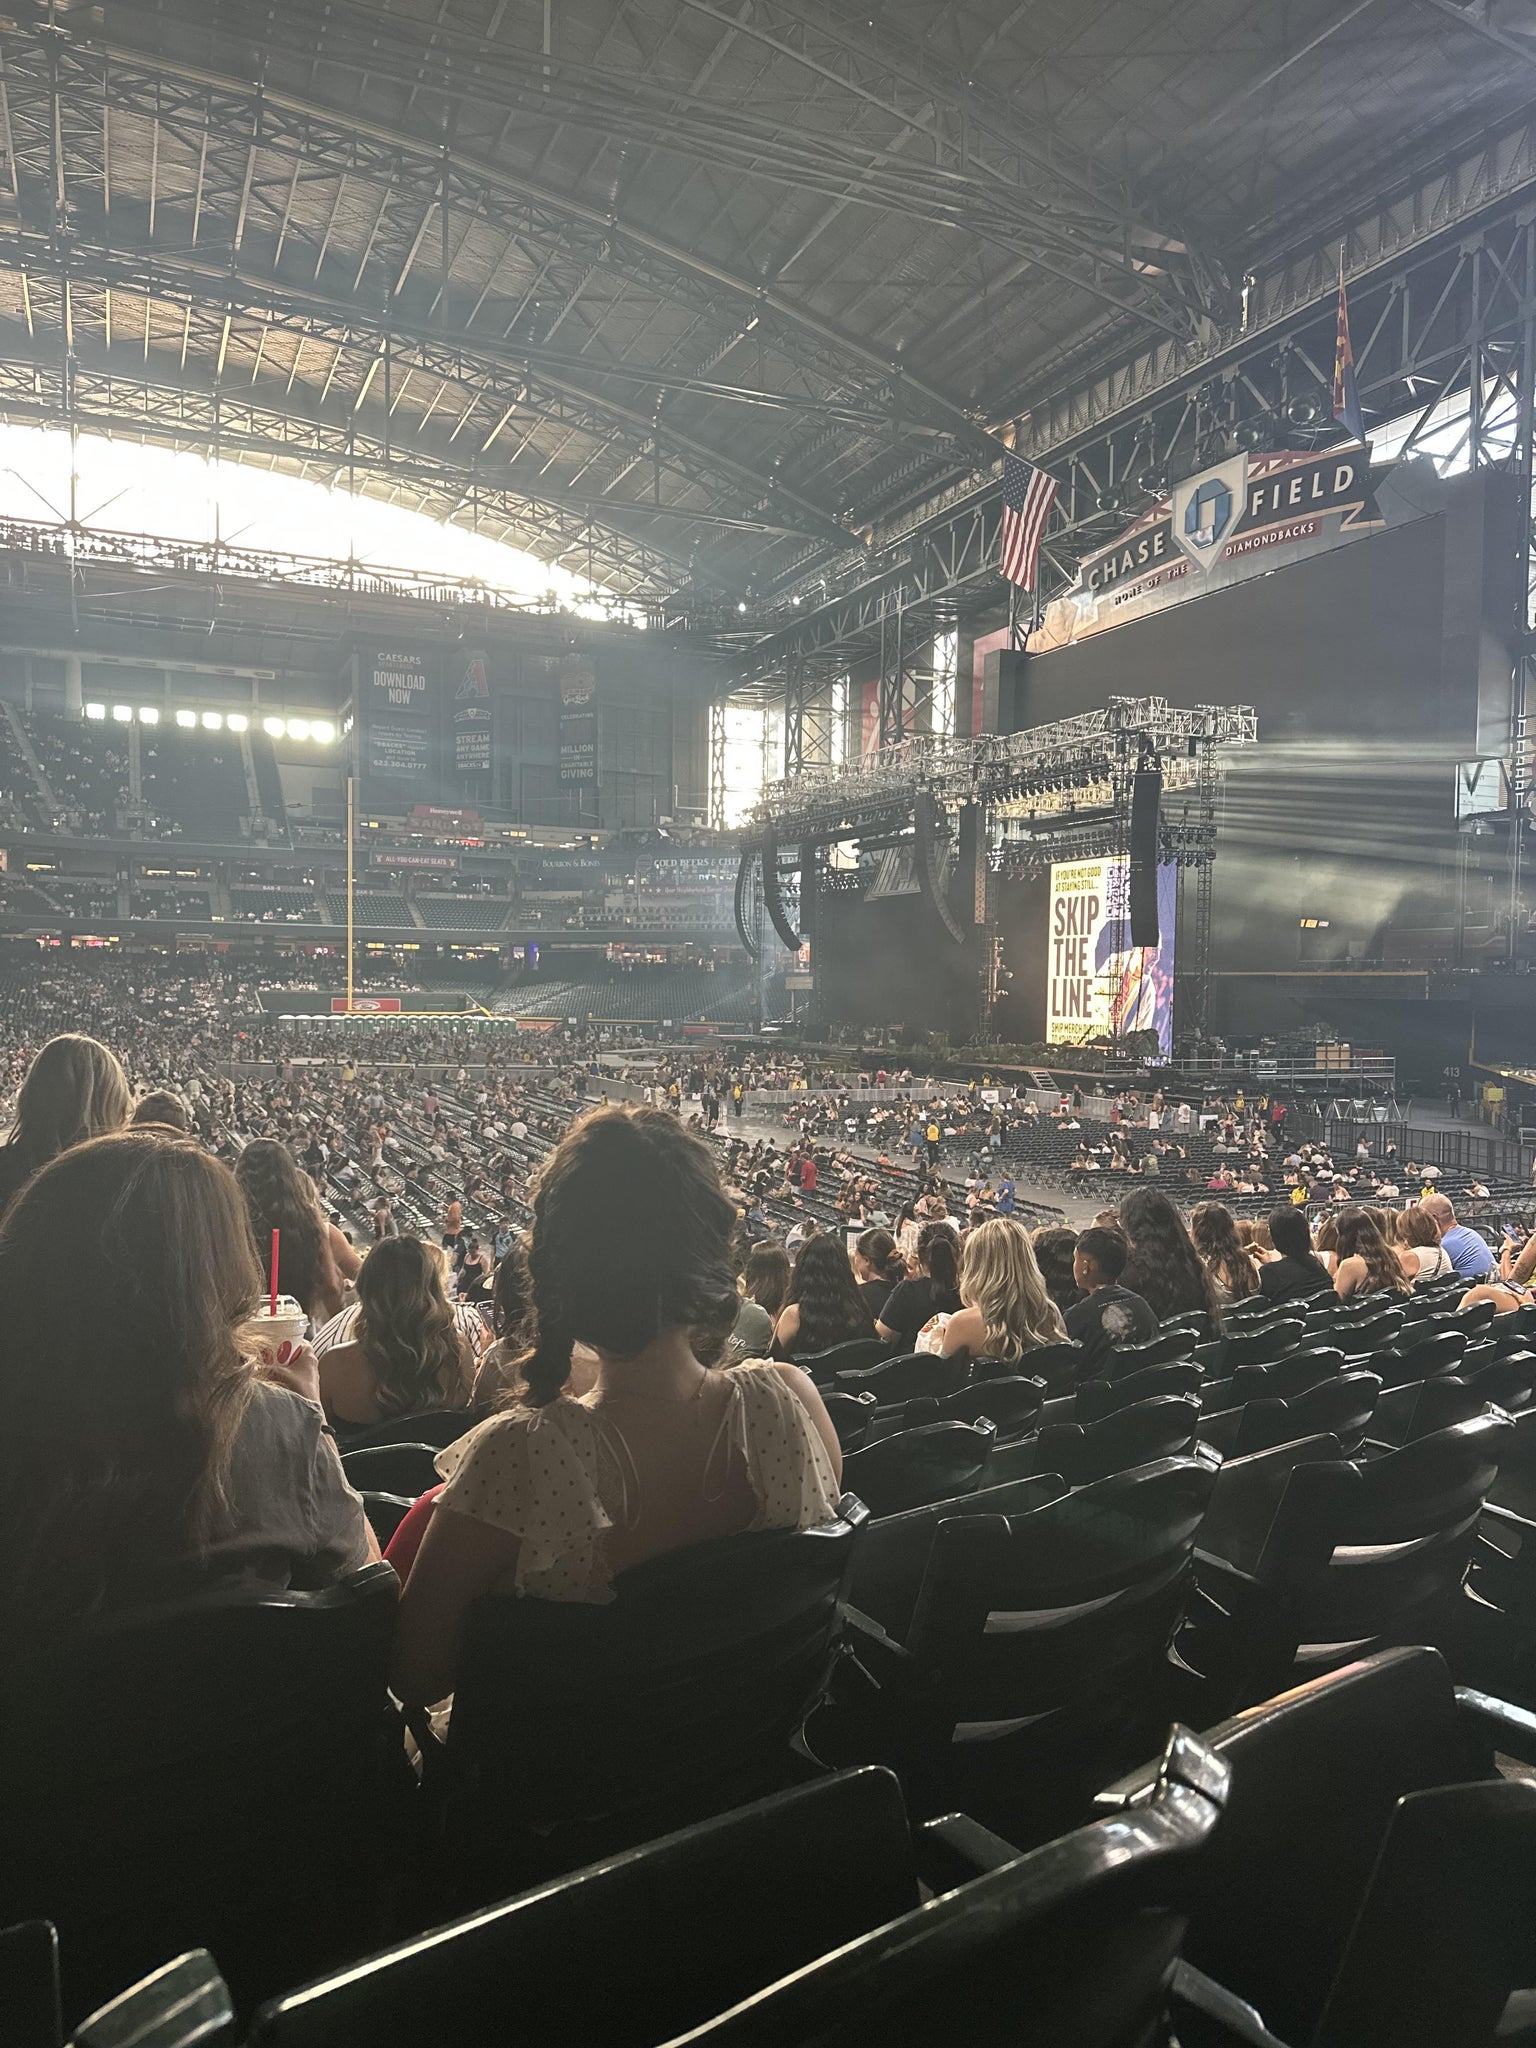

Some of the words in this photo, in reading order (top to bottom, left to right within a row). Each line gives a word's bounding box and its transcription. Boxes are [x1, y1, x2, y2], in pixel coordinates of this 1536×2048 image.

[1087, 531, 1165, 592] CHASE
[1252, 465, 1354, 516] FIELD
[1115, 585, 1142, 606] HOME
[1147, 574, 1162, 591] OF
[1167, 563, 1189, 582] THE
[1225, 523, 1315, 557] DIAMONDBACKS
[377, 653, 422, 665] CAESARS
[373, 671, 425, 690] DOWNLOAD
[388, 688, 411, 705] NOW
[456, 734, 490, 744] STREAM
[470, 743, 490, 752] GAME
[560, 744, 594, 755] MILLION
[456, 752, 490, 761] ANYWHERE
[560, 769, 594, 780] GIVING
[430, 807, 462, 816] Honeywell
[430, 857, 447, 866] SEATS
[654, 858, 677, 867] COLD
[680, 857, 709, 867] BEERS
[1055, 870, 1060, 881] IF
[1060, 868, 1077, 880] YOU'RE
[1077, 867, 1087, 878] NOT
[1087, 865, 1102, 877] GOOD
[1055, 882, 1061, 892] AT
[1054, 895, 1100, 936] SKIP
[1054, 938, 1089, 976] THE
[1052, 979, 1093, 1018] LINE
[1051, 1022, 1063, 1033] SHIP
[1064, 1023, 1082, 1034] MERCH
[1443, 1066, 1460, 1078] 413
